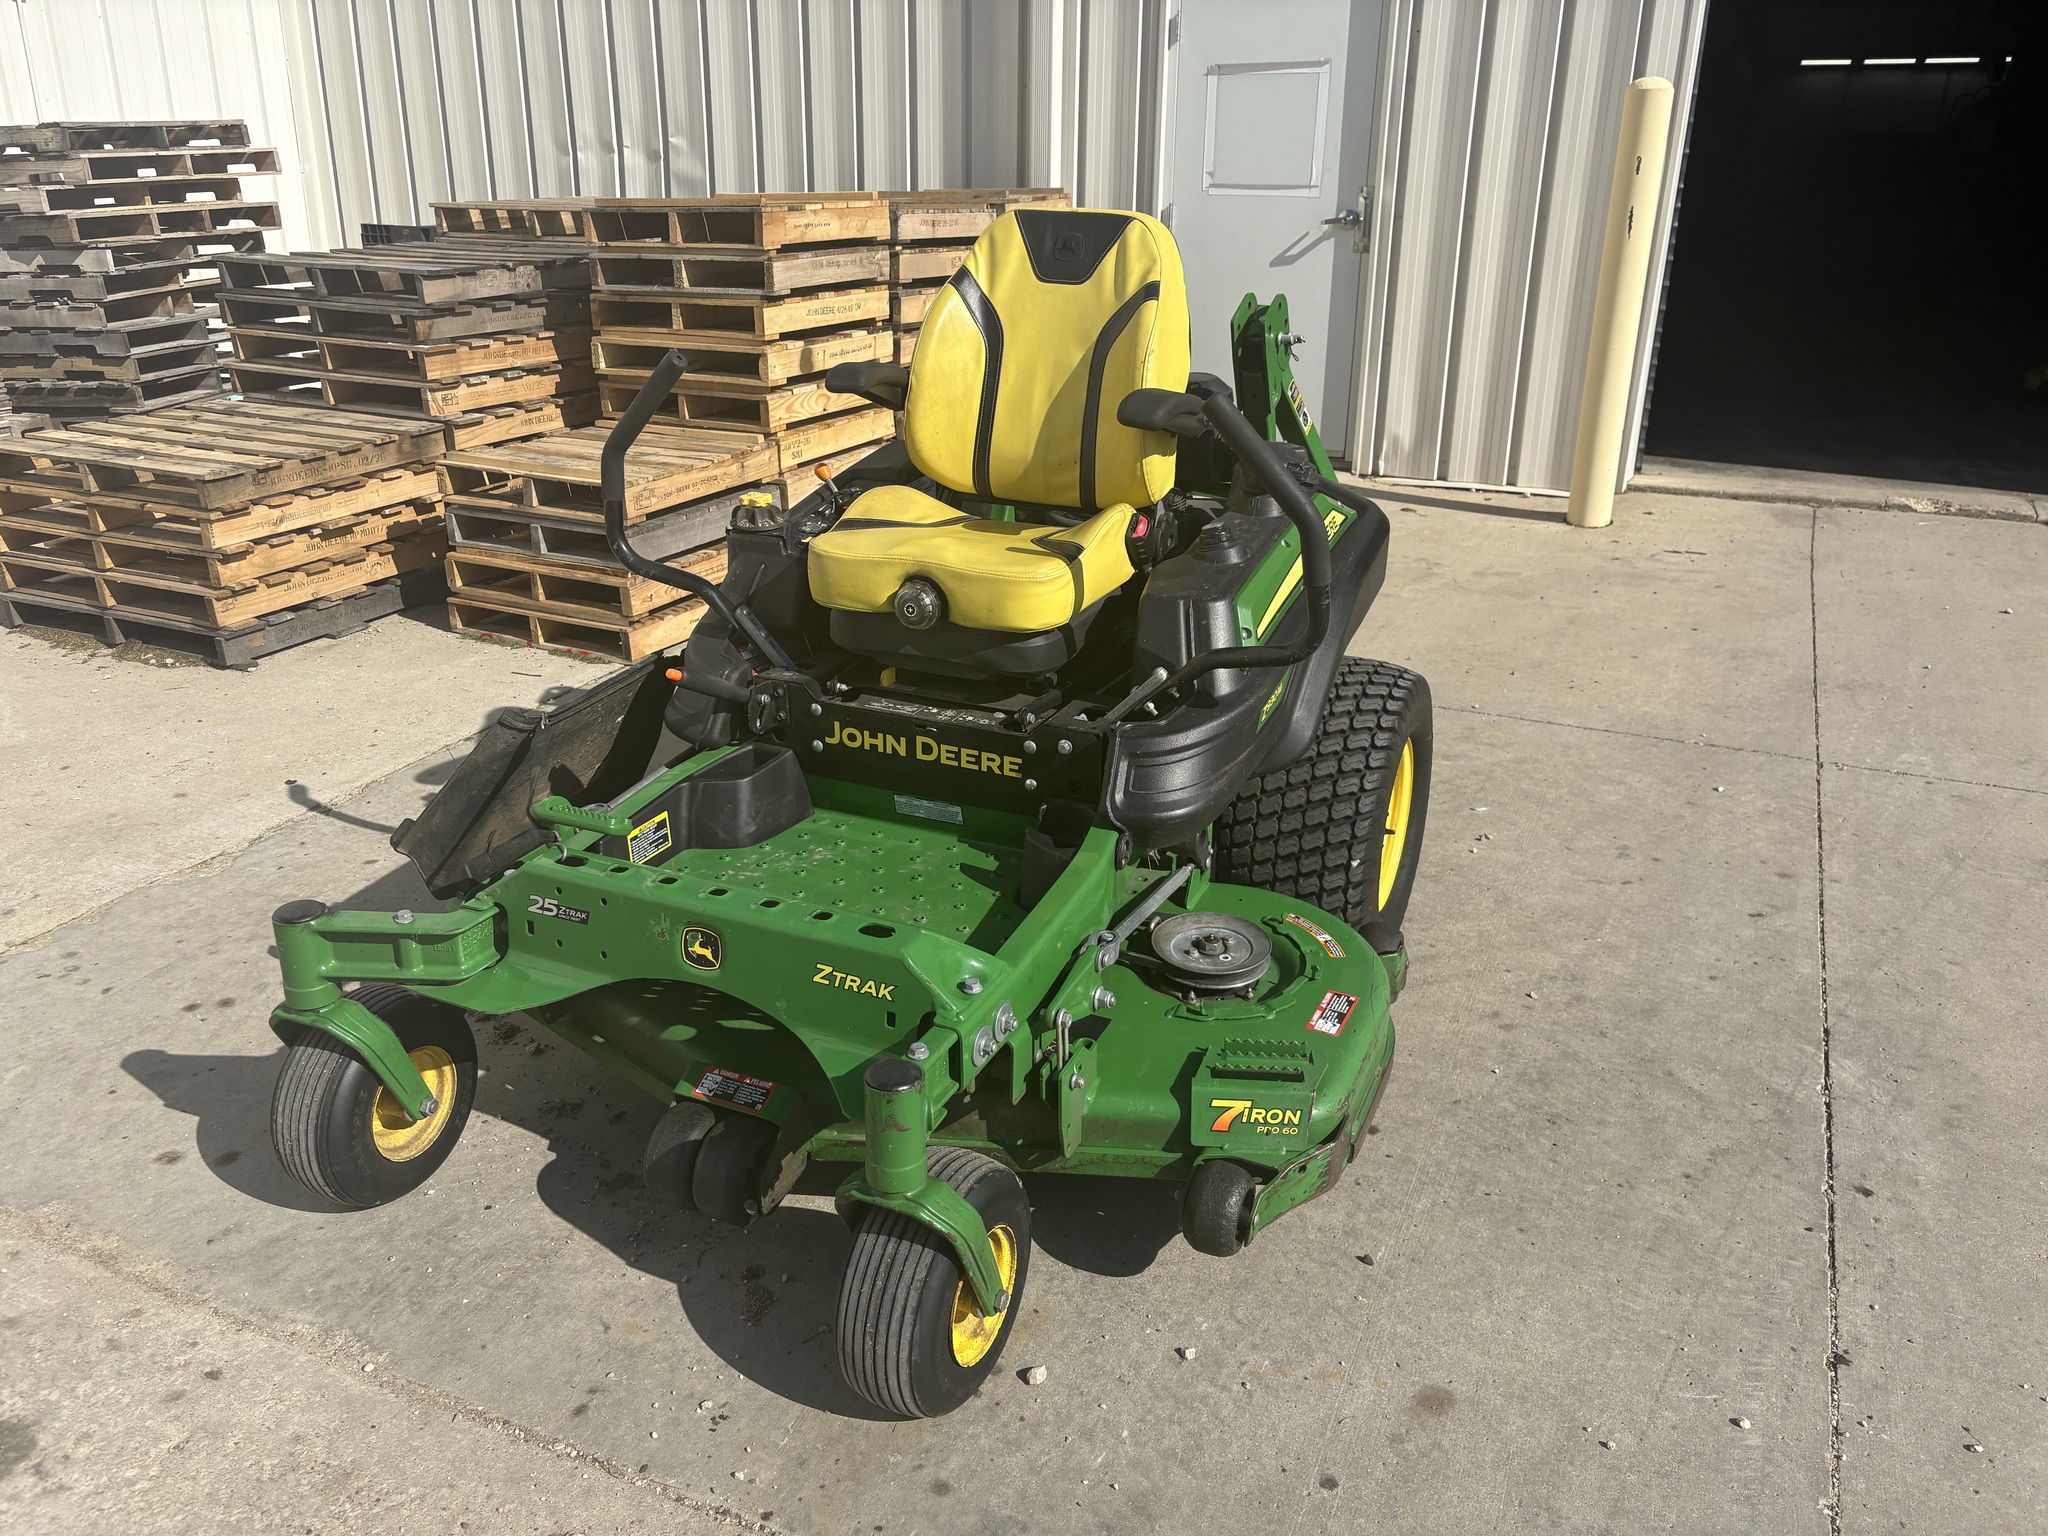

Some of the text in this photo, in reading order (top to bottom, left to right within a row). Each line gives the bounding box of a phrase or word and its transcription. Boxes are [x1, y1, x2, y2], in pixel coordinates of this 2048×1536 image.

[820, 305, 836, 315] DEERE
[825, 721, 1023, 779] JOHN DEERE
[528, 894, 559, 916] 25
[558, 906, 588, 920] ZTRAK
[812, 963, 896, 1002] ZTRAK
[719, 1069, 740, 1080] DANGER
[1241, 1107, 1302, 1125] IRON
[1282, 1127, 1299, 1135] 60
